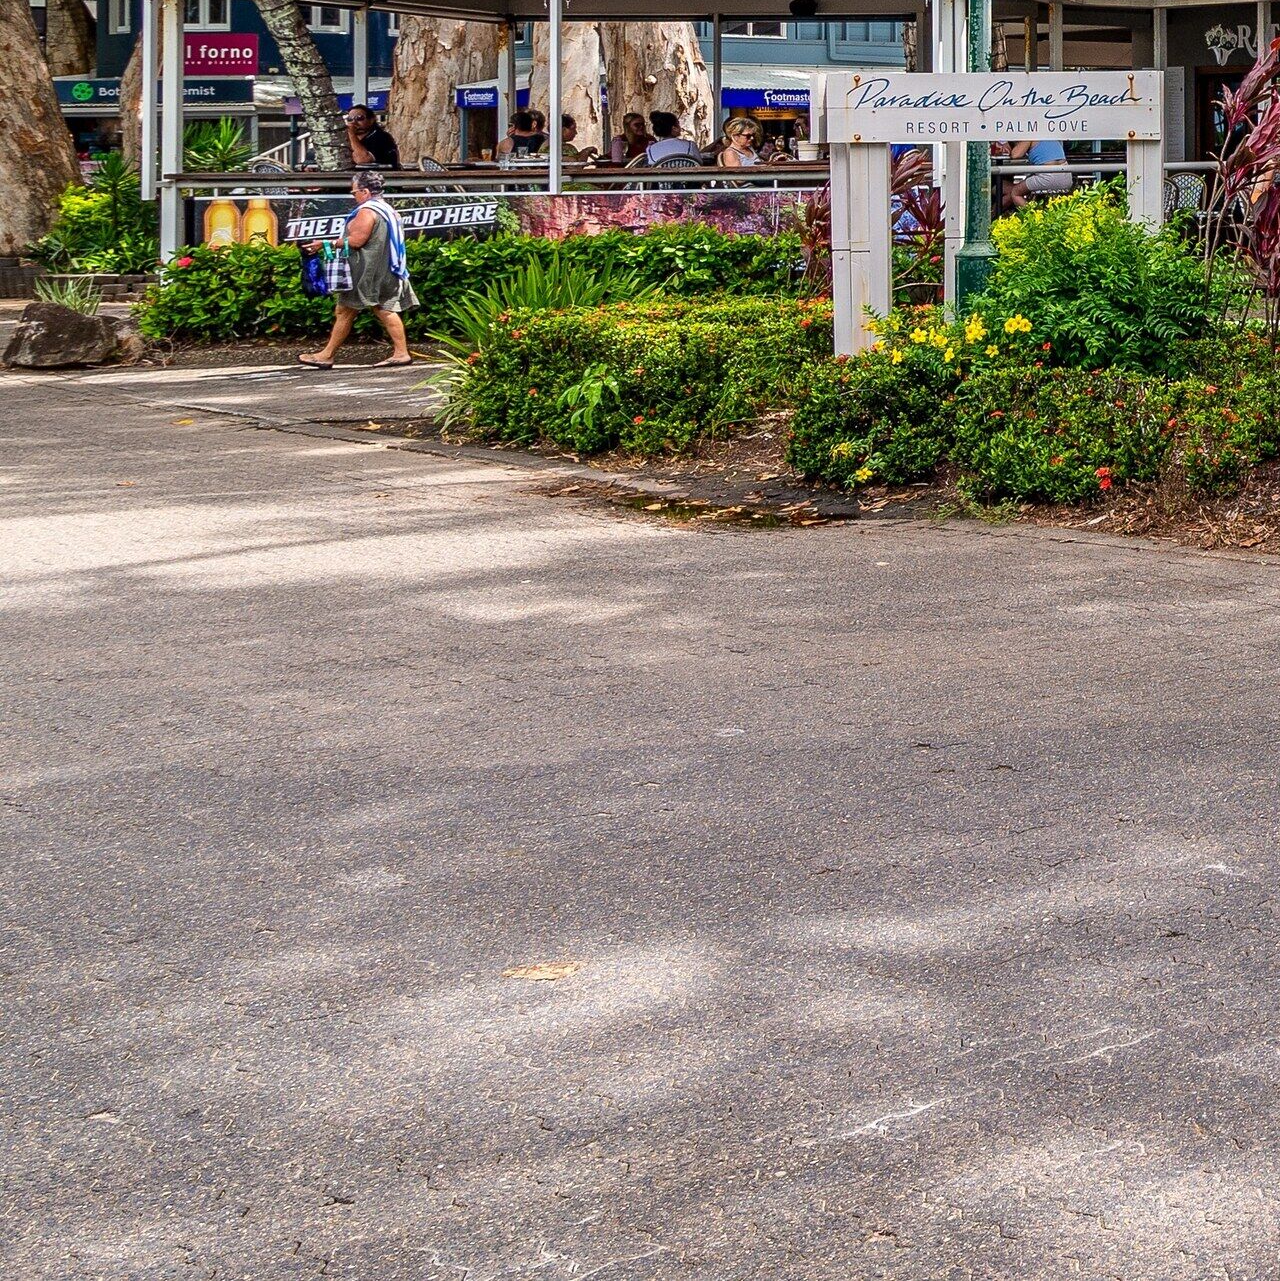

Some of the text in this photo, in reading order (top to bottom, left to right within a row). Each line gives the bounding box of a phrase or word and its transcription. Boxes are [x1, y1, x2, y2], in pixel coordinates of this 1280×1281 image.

[199, 45, 253, 58] forno
[847, 78, 1143, 119] Paradise On the Beach
[906, 120, 1089, 134] RESORT PALM COVE
[286, 220, 329, 238] THE
[413, 209, 445, 227] UP
[443, 204, 499, 225] HERE
